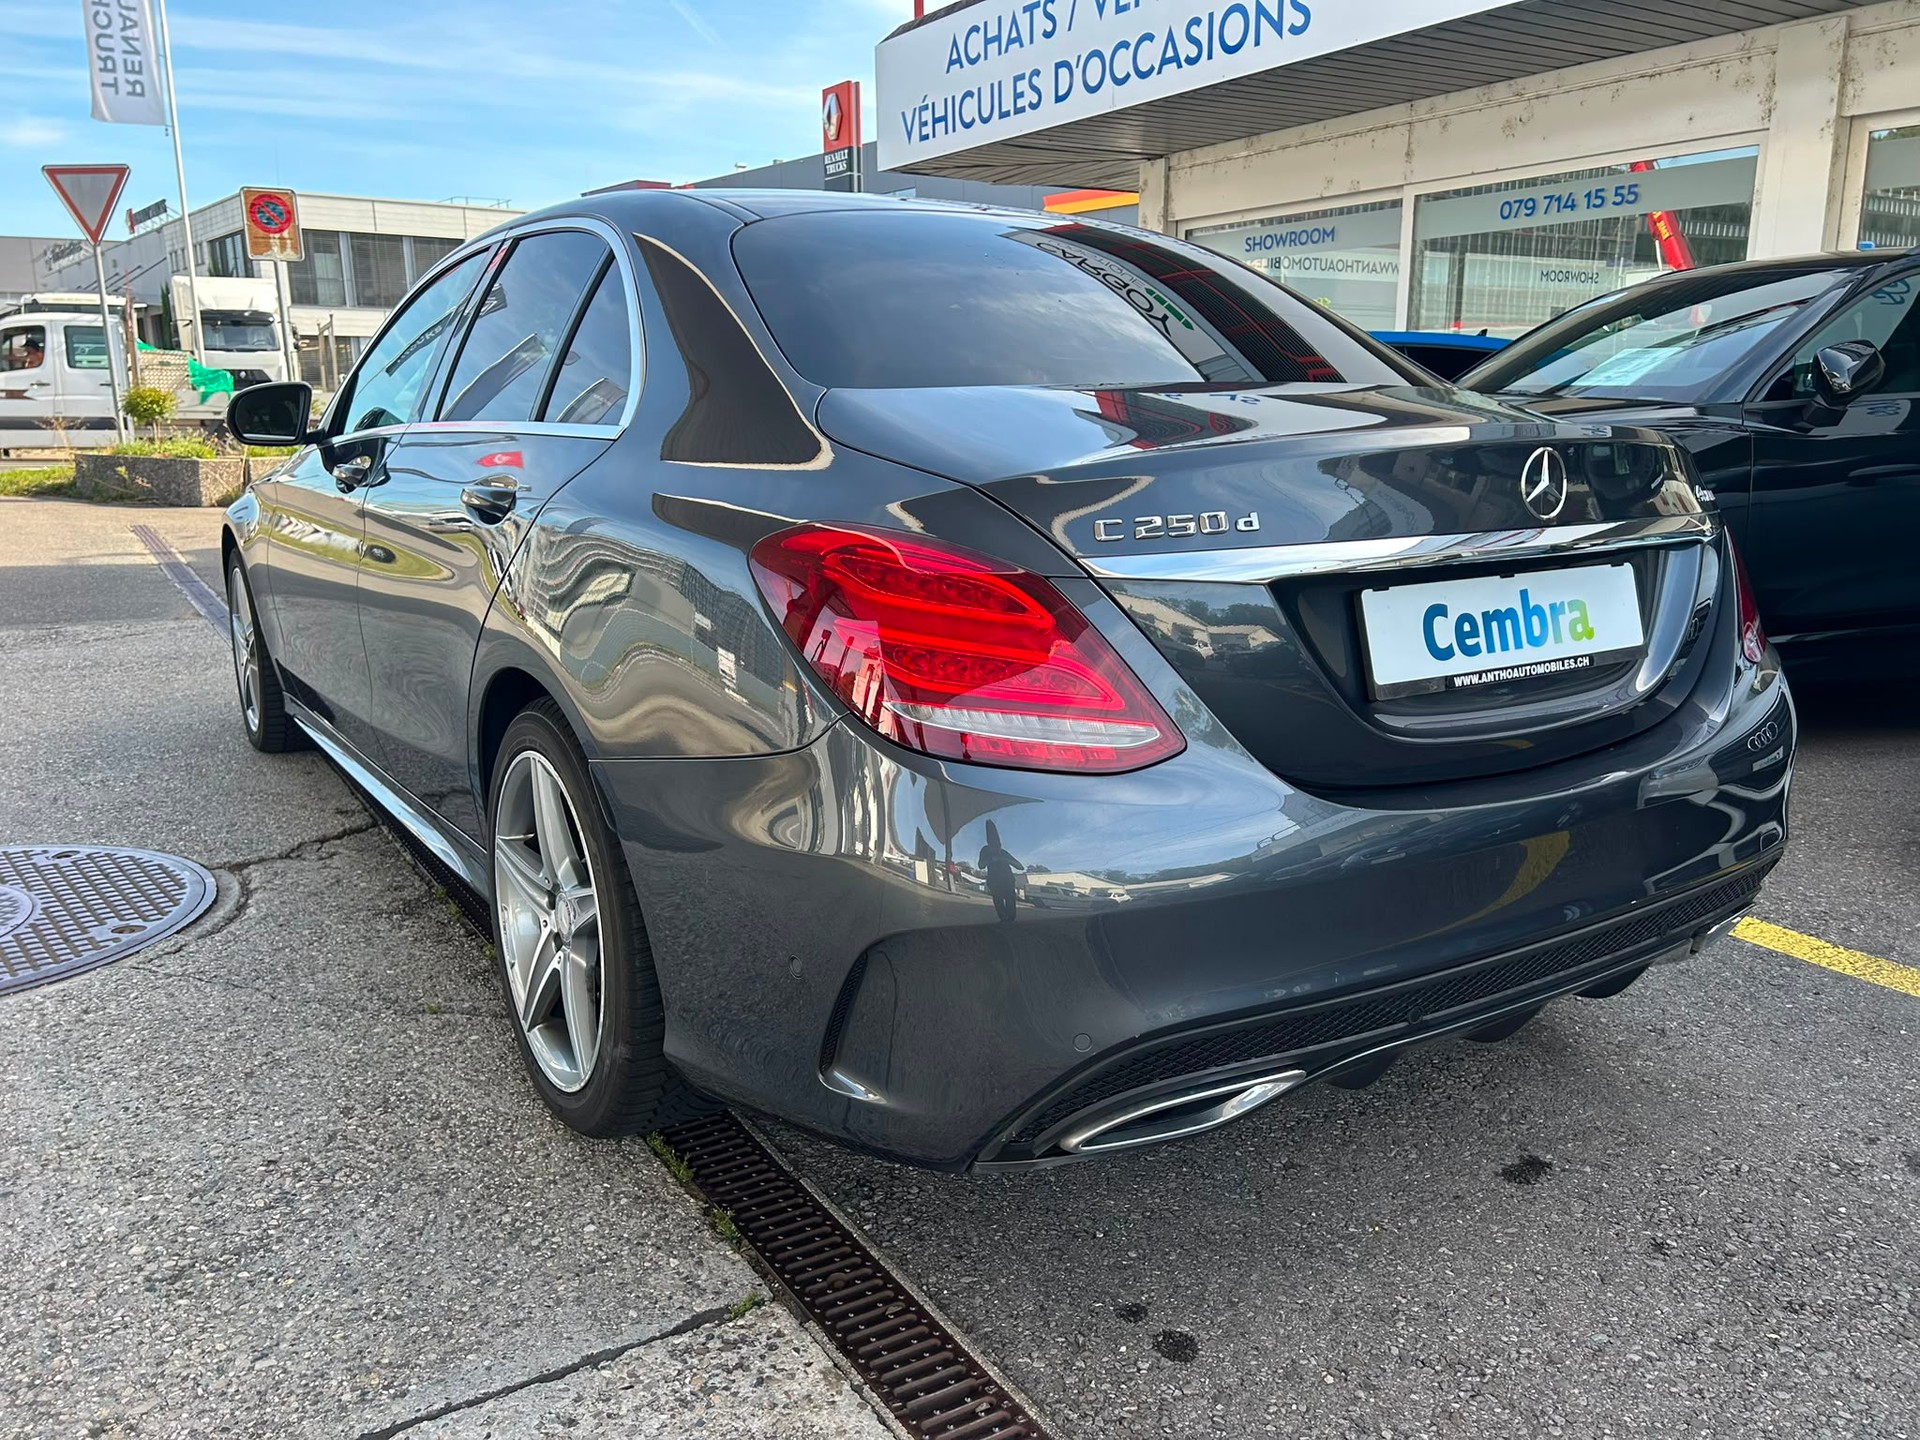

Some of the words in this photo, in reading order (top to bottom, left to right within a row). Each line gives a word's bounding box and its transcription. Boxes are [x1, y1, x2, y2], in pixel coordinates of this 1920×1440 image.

[945, 0, 1057, 74] ACHATS
[901, 68, 1043, 145] VÉHICULES
[1054, 0, 1312, 104] D'OCCASIONS
[824, 149, 849, 165] RENAULT
[826, 160, 848, 175] TRUCKS
[1500, 197, 1537, 220] 079
[1543, 192, 1577, 215] 714
[1584, 188, 1606, 210] 15
[1612, 183, 1640, 206] 55
[1244, 226, 1336, 252] SHOWROOM
[1093, 518, 1125, 542] C
[1134, 511, 1230, 540] 250
[1236, 511, 1261, 532] d
[1422, 589, 1595, 661] Cembra
[1454, 656, 1590, 687] WWW.ANTHOAUTOMOBILES.CH
